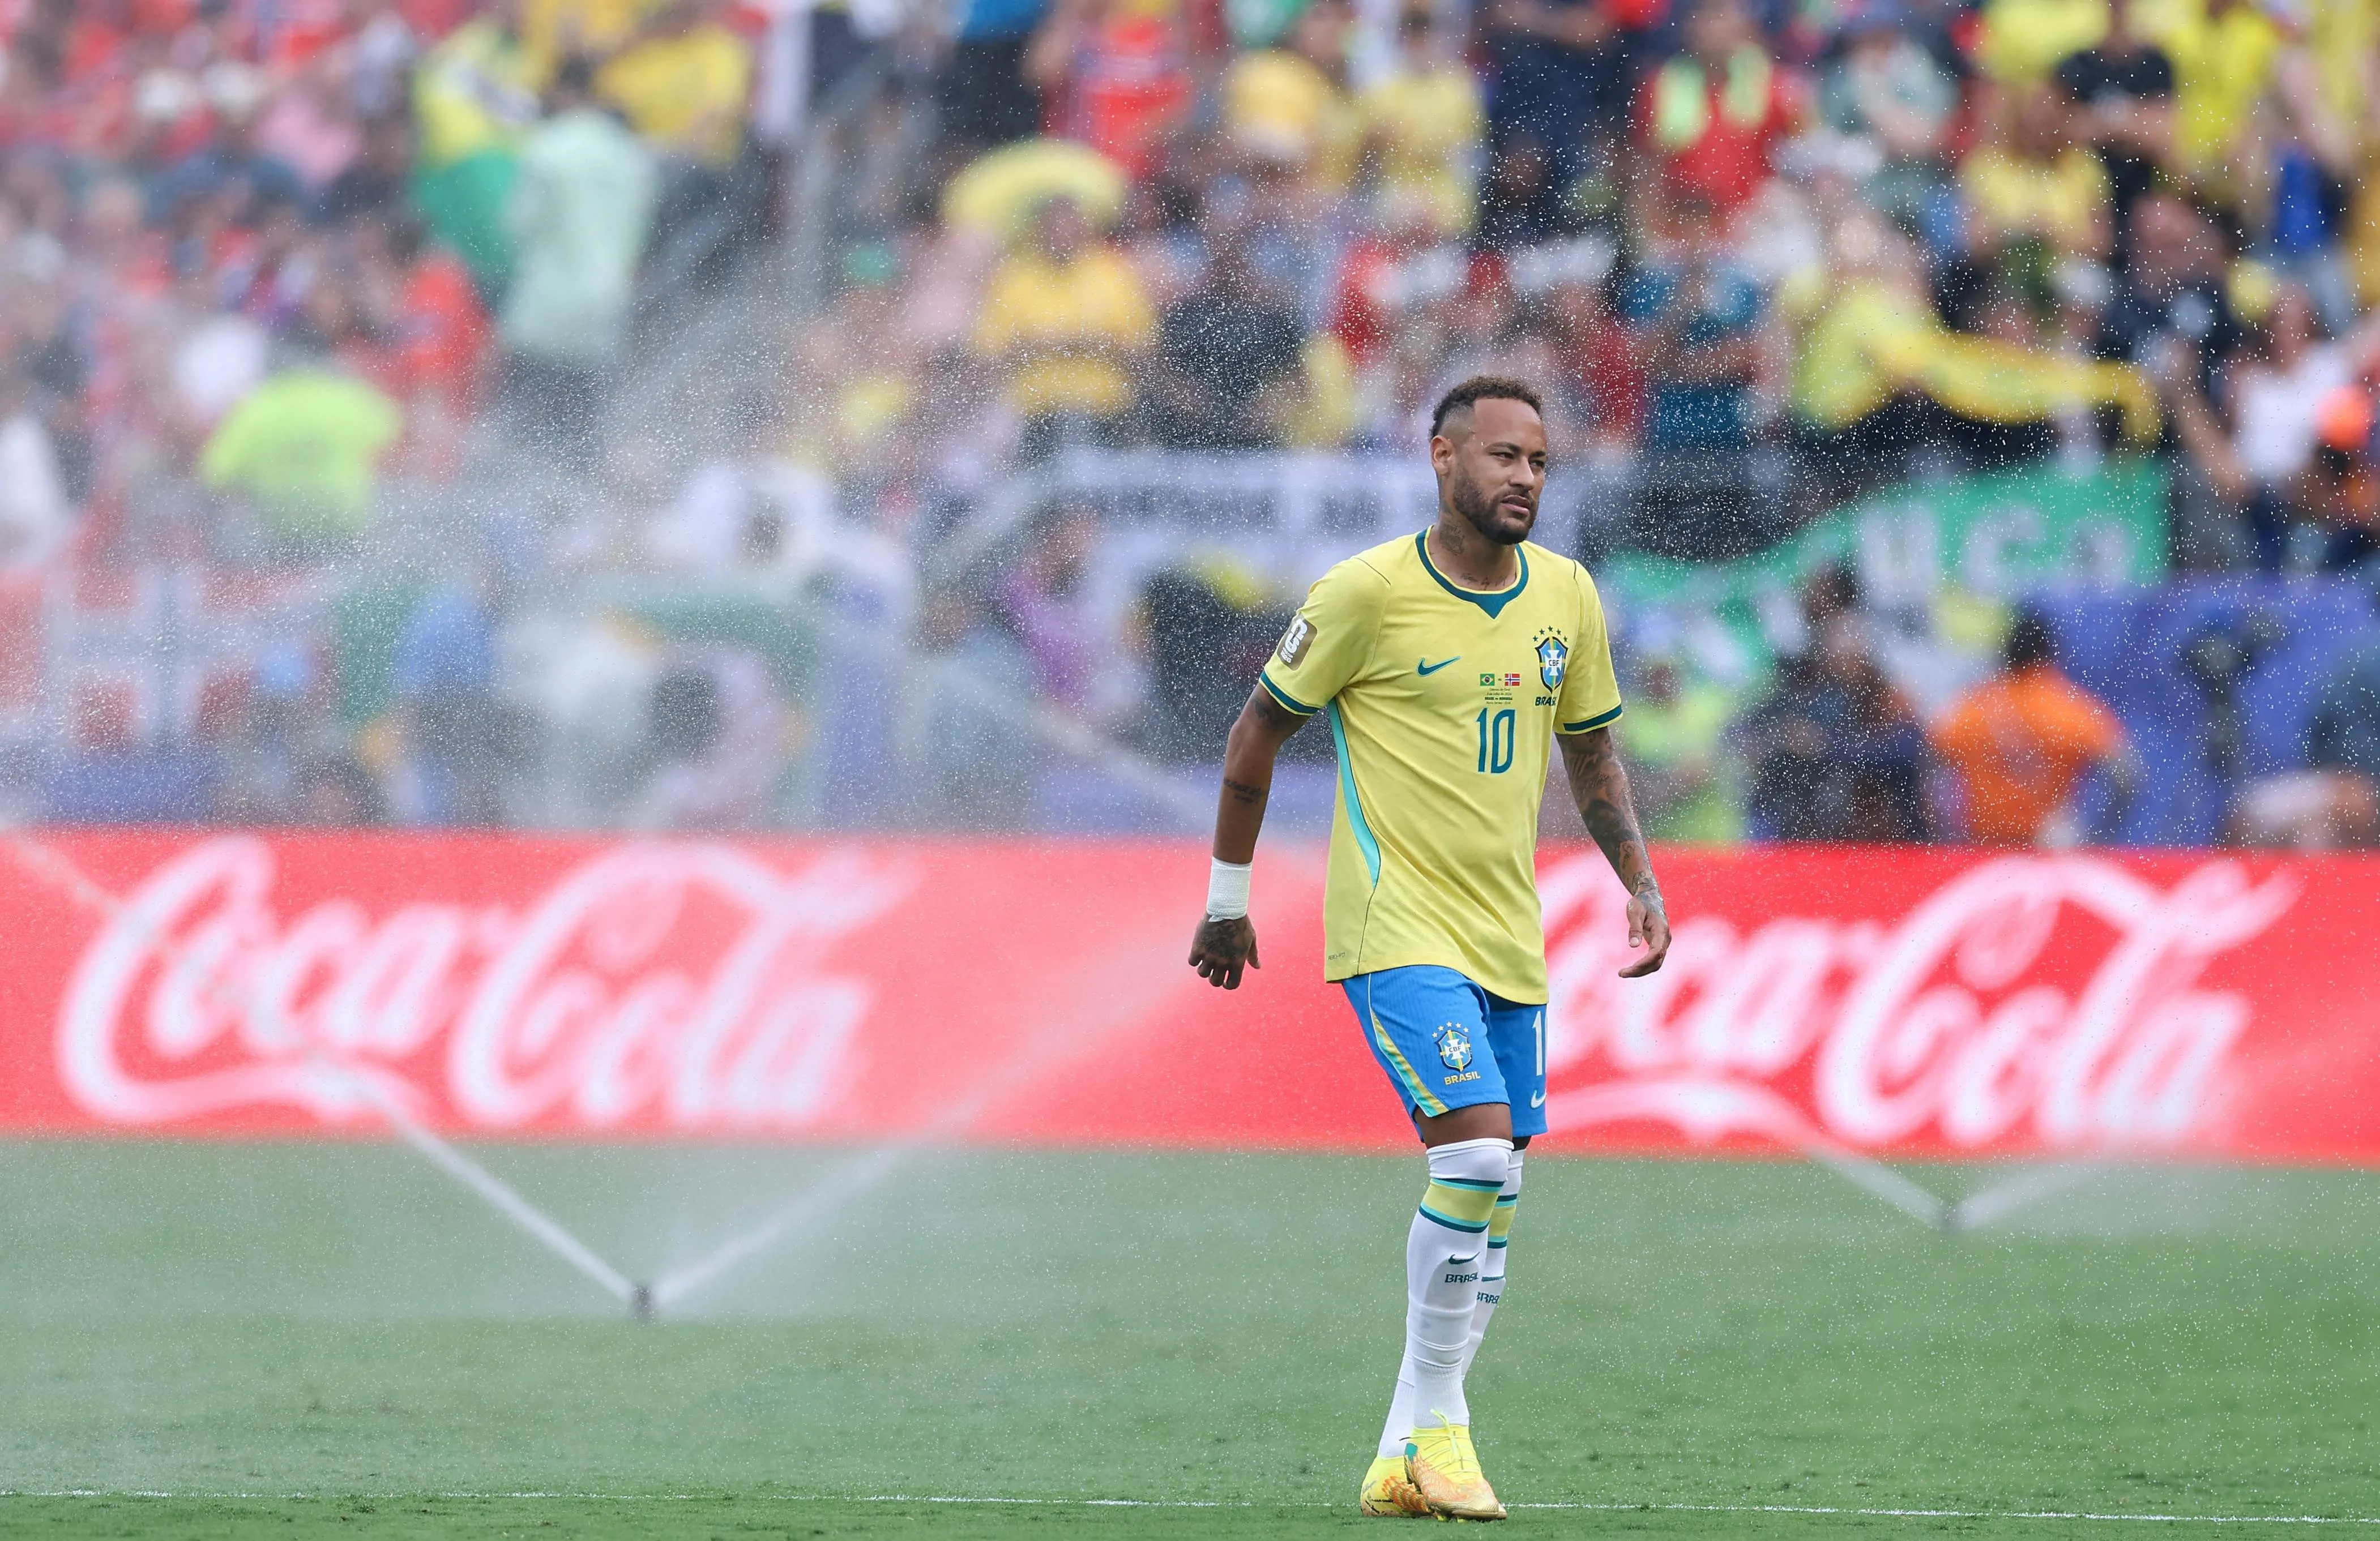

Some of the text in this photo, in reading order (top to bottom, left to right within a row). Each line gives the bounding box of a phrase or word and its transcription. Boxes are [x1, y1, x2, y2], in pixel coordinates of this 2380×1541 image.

[1476, 707, 1516, 774] 10
[54, 834, 929, 1124] Coca-Cola
[1444, 1071, 1481, 1085] BRASIL
